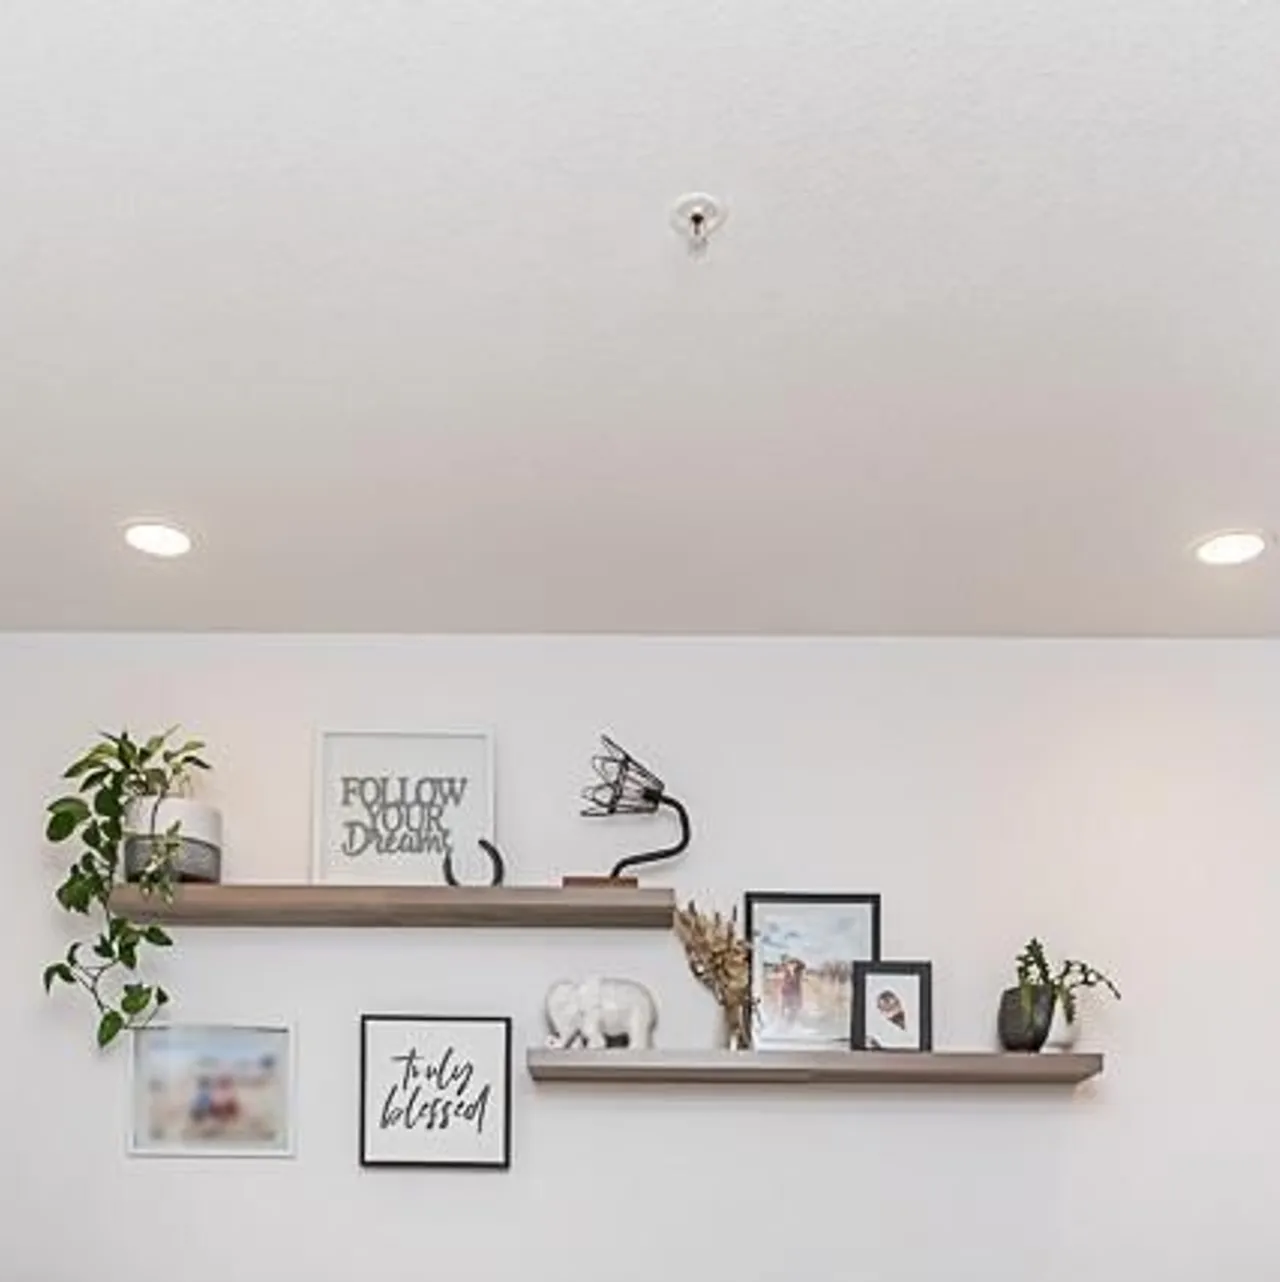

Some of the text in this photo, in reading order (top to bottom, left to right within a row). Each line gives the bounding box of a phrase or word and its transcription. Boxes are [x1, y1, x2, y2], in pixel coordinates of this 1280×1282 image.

[340, 776, 468, 806] FOLLOW
[365, 801, 446, 833] YOUR
[390, 1046, 474, 1096] truly
[379, 1084, 491, 1134] blessed
